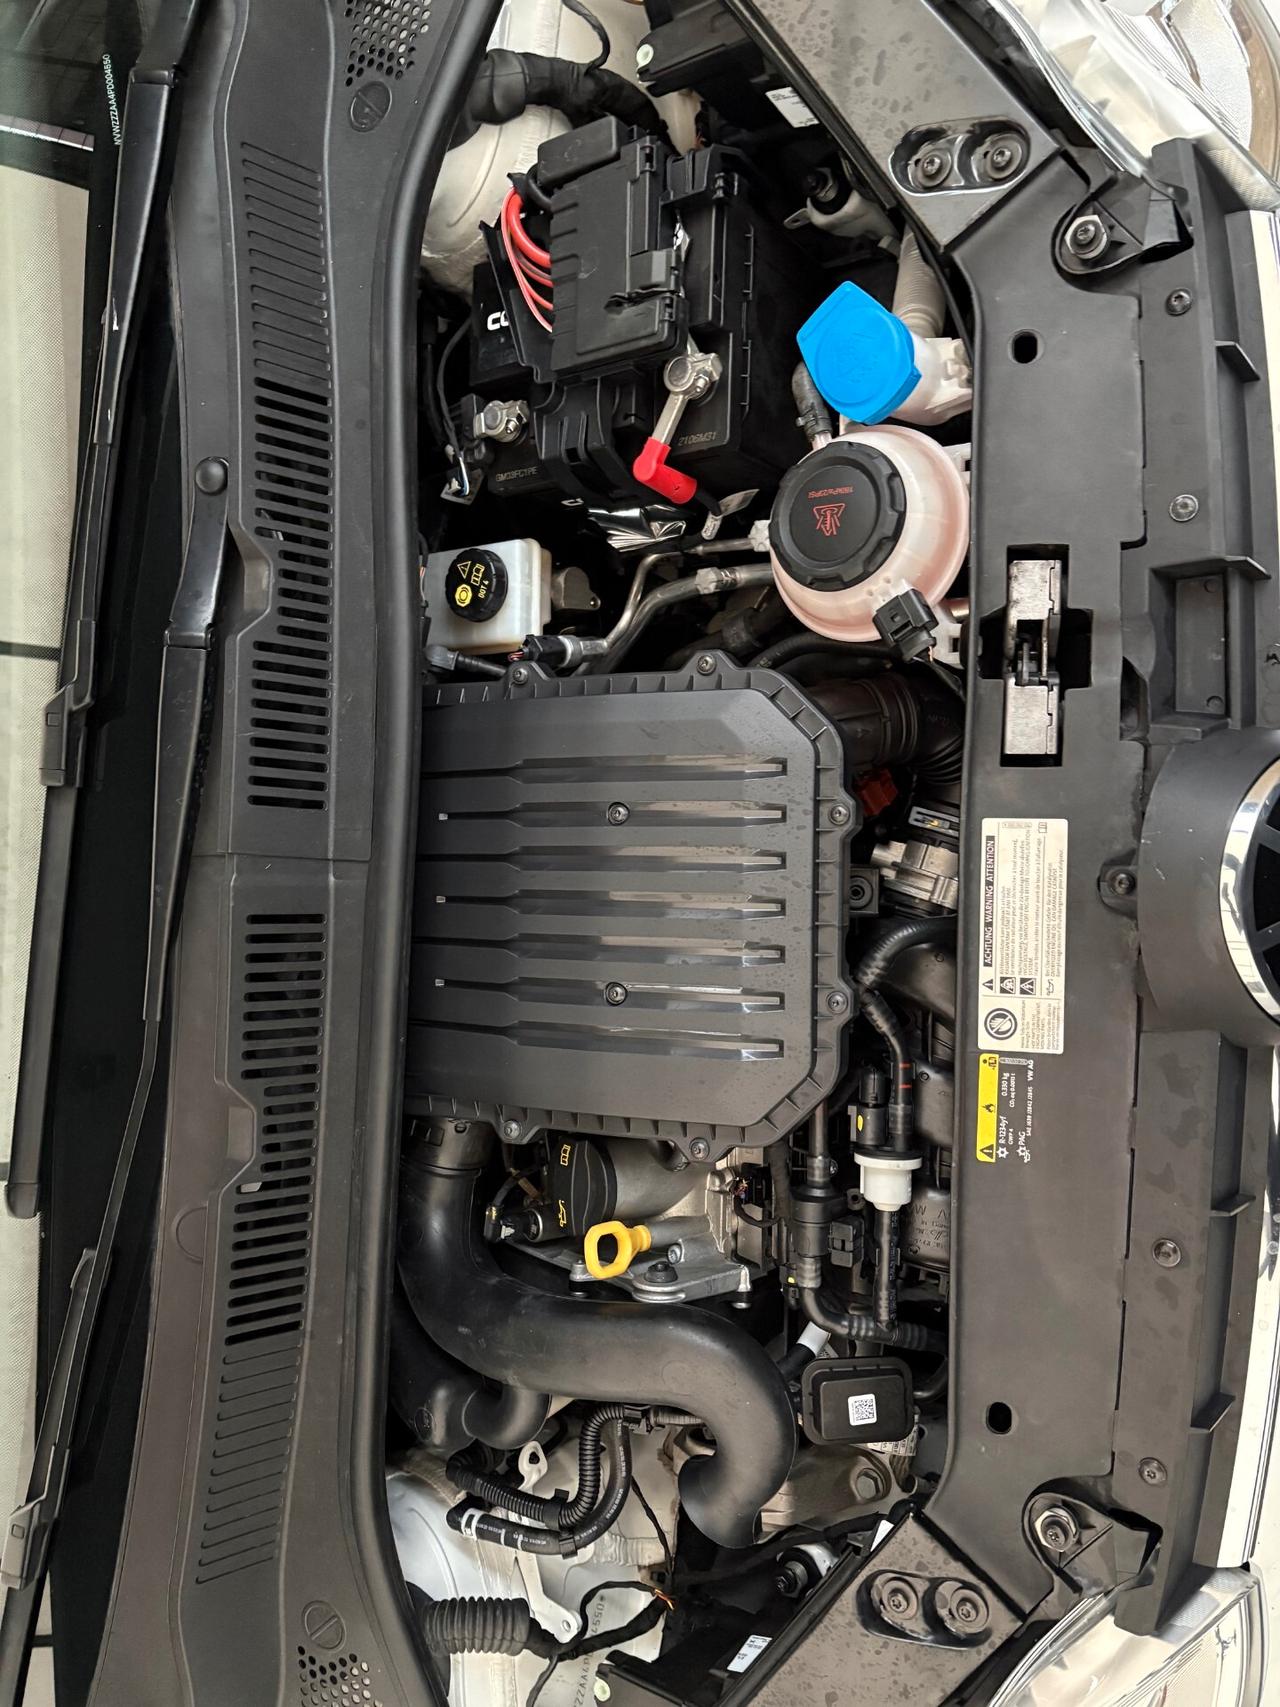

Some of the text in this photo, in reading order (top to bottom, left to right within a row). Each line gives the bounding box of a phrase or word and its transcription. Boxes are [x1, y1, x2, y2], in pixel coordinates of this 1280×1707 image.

[478, 585, 488, 599] DOT
[986, 841, 994, 882] ATTENTION
[1028, 1059, 1034, 1070] AG
[1027, 1071, 1033, 1081] VW
[1000, 1116, 1008, 1144] R-1234yf
